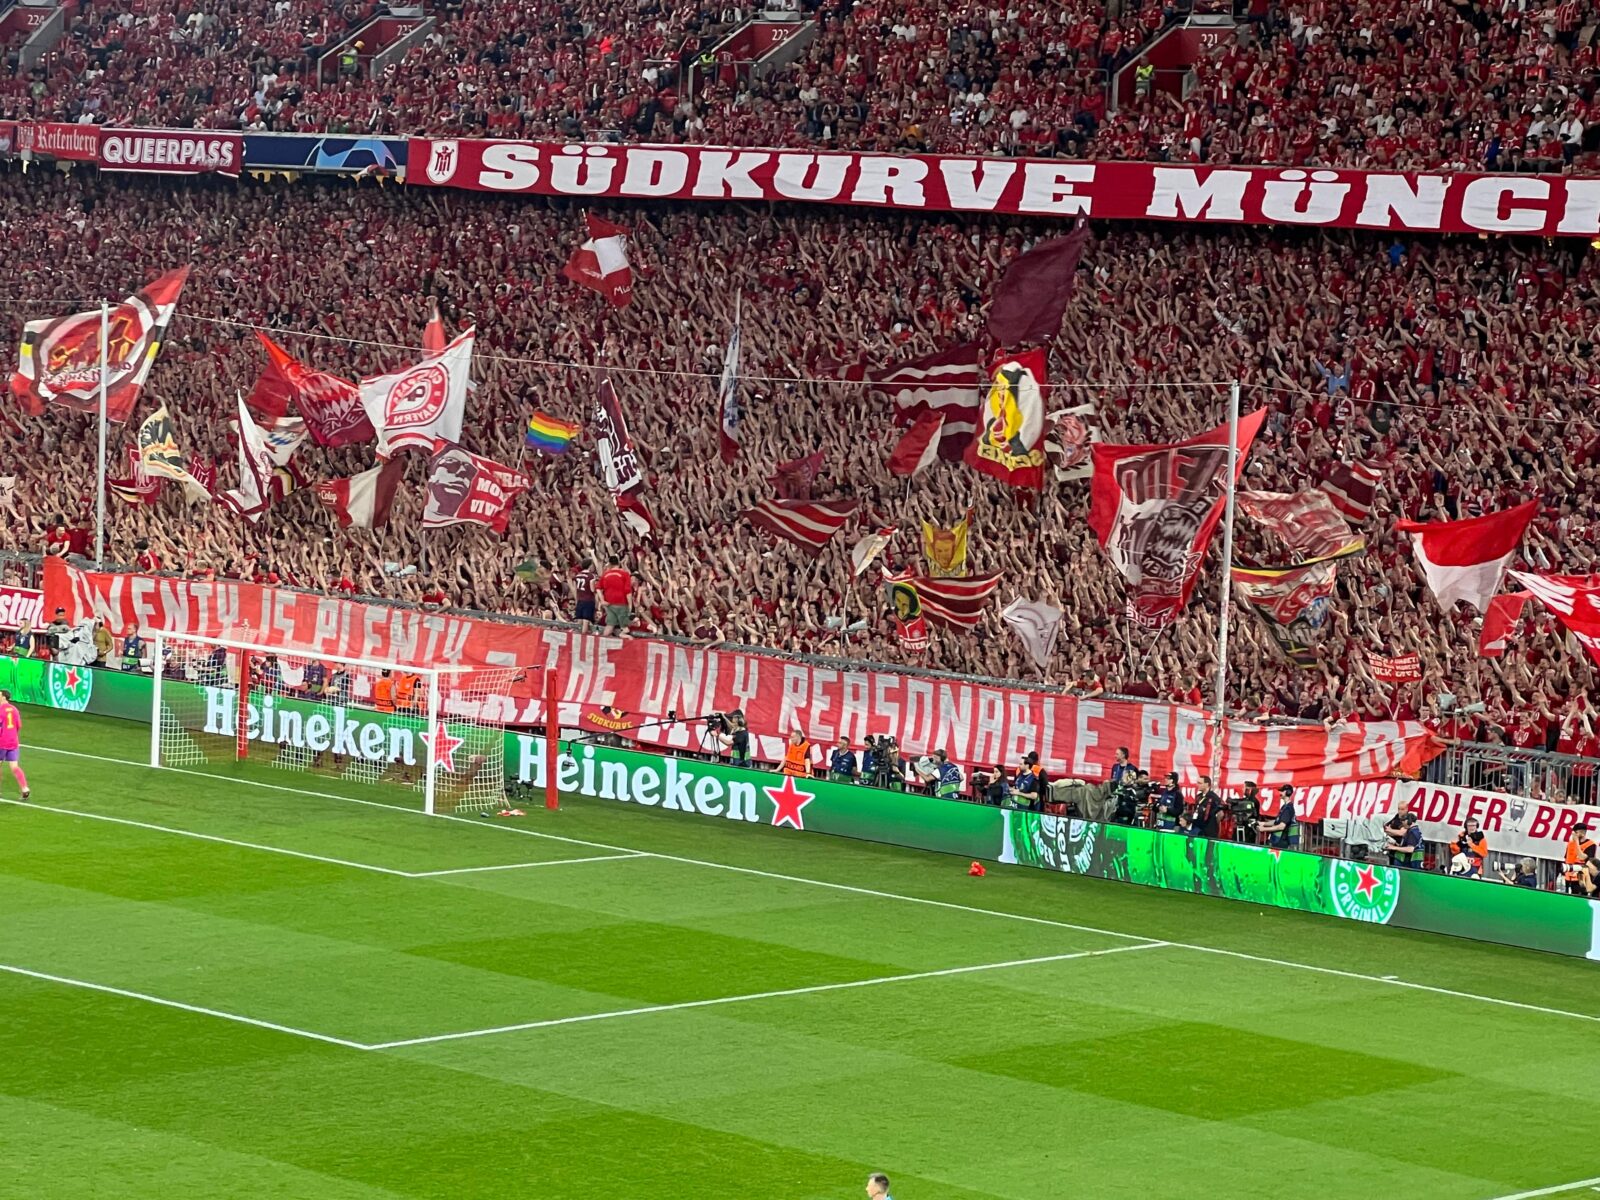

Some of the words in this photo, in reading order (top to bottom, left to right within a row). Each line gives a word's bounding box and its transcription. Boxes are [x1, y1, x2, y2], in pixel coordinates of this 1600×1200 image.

[1201, 33, 1218, 48] 221
[38, 125, 97, 156] Reifenberg
[102, 136, 234, 165] QUEERPASS
[478, 144, 1096, 215] SÜDKURVE
[66, 566, 239, 640] TWENTY
[261, 588, 295, 645] IS
[312, 596, 472, 684] PLENTY
[541, 630, 624, 705] THE
[639, 642, 759, 716] ONLY
[778, 664, 1105, 776] REASONABLE
[6, 711, 14, 728] 1
[204, 686, 417, 765] Heineken
[517, 735, 759, 823] Heineken
[1325, 781, 1392, 820] PRIDE
[1406, 787, 1507, 832] ADLER
[1337, 882, 1385, 922] ORIGINAL
